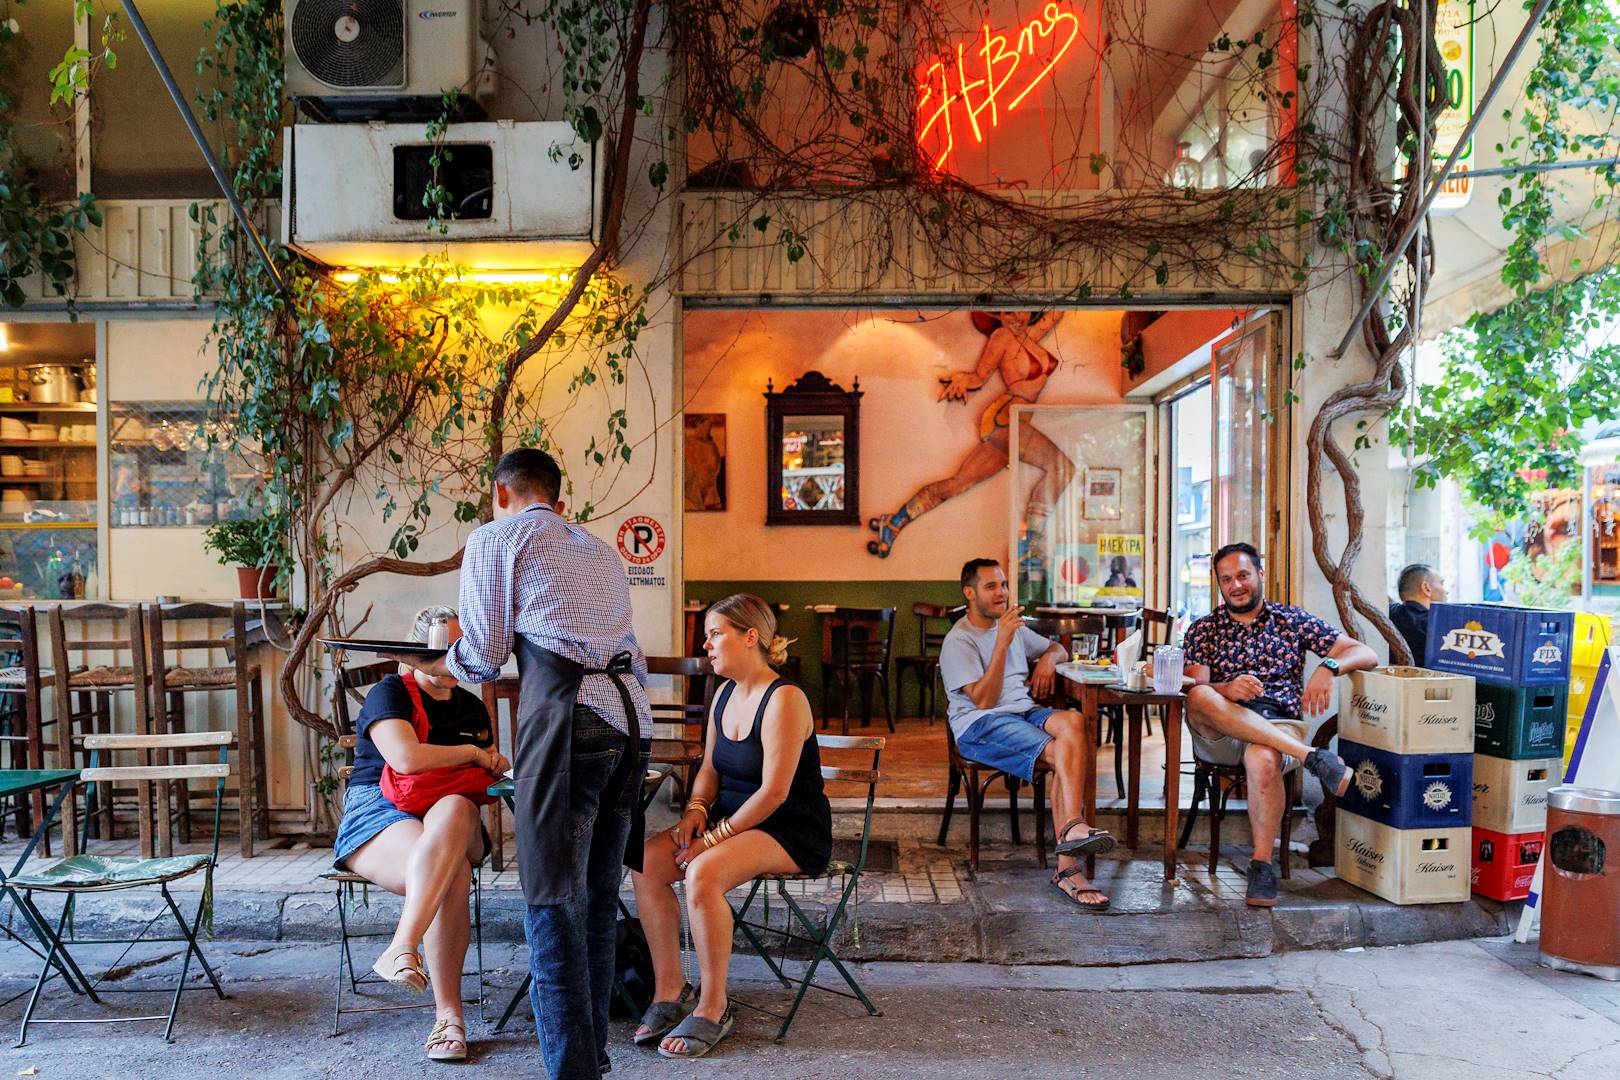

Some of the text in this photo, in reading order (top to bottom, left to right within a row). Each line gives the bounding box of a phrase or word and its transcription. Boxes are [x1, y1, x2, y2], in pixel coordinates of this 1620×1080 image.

[628, 566, 654, 575] ΕΙΣΟΔΟΣ
[626, 577, 666, 586] ΑΣΤΗΜΑΤΟΣ
[1454, 633, 1493, 651] FIX
[1539, 649, 1556, 659] FIX
[1351, 694, 1387, 713] Kaiser
[1417, 713, 1458, 725] Kaiser
[1346, 838, 1385, 864] Kaiser
[1415, 862, 1456, 874] Kaiser
